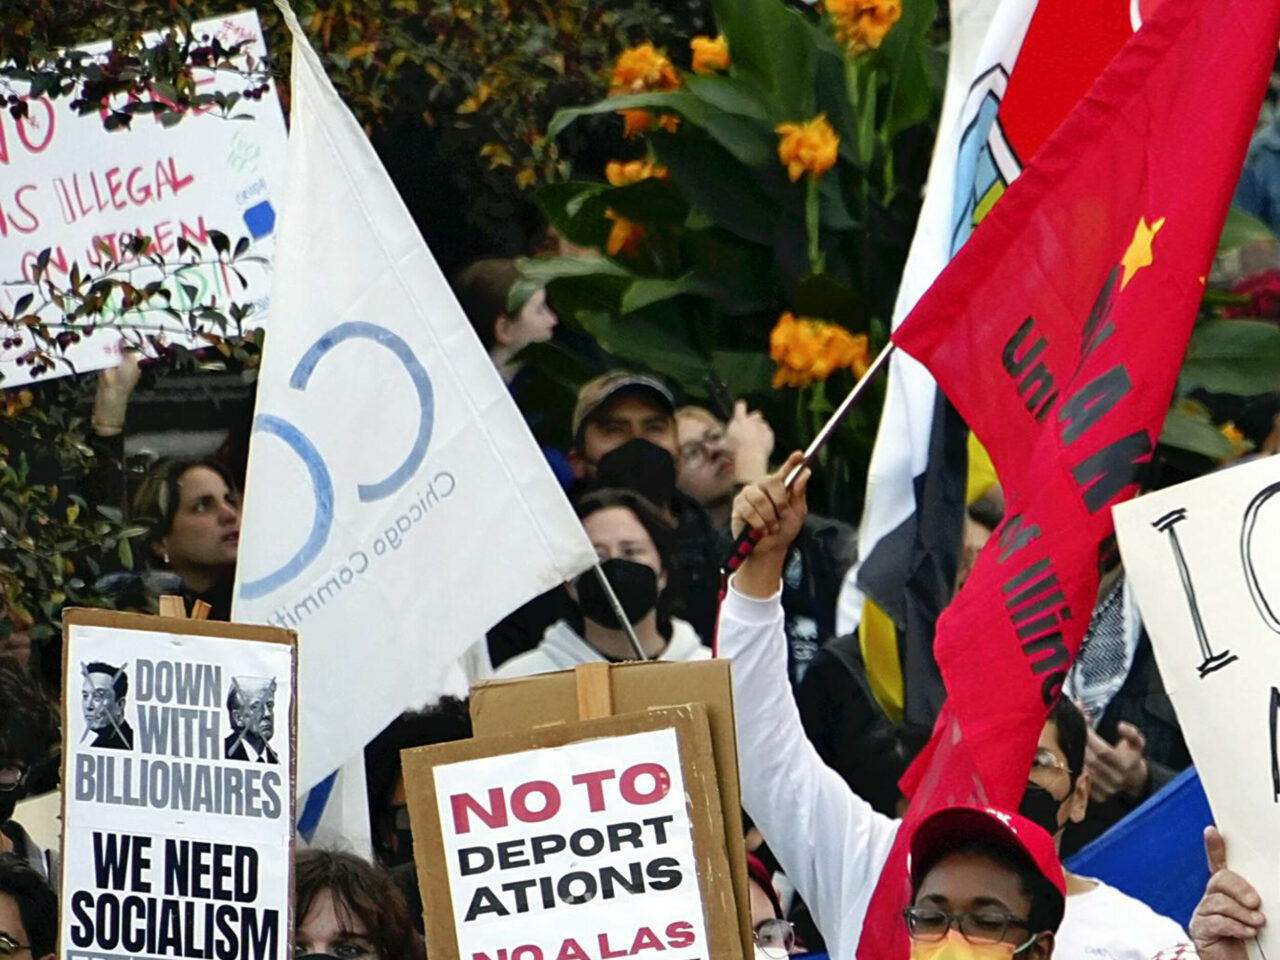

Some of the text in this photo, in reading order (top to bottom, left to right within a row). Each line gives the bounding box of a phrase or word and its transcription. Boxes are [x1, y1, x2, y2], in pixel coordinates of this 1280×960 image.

[53, 157, 194, 225] ILLEGAL
[135, 659, 222, 708] DOWN
[136, 705, 220, 760] WITH
[75, 753, 282, 820] BILLIONAIRES
[450, 762, 671, 835] NO TO
[92, 831, 259, 903] WE NEED
[457, 815, 674, 877] DEPORT
[464, 857, 683, 922] ATIONS
[597, 921, 696, 960] LAS
